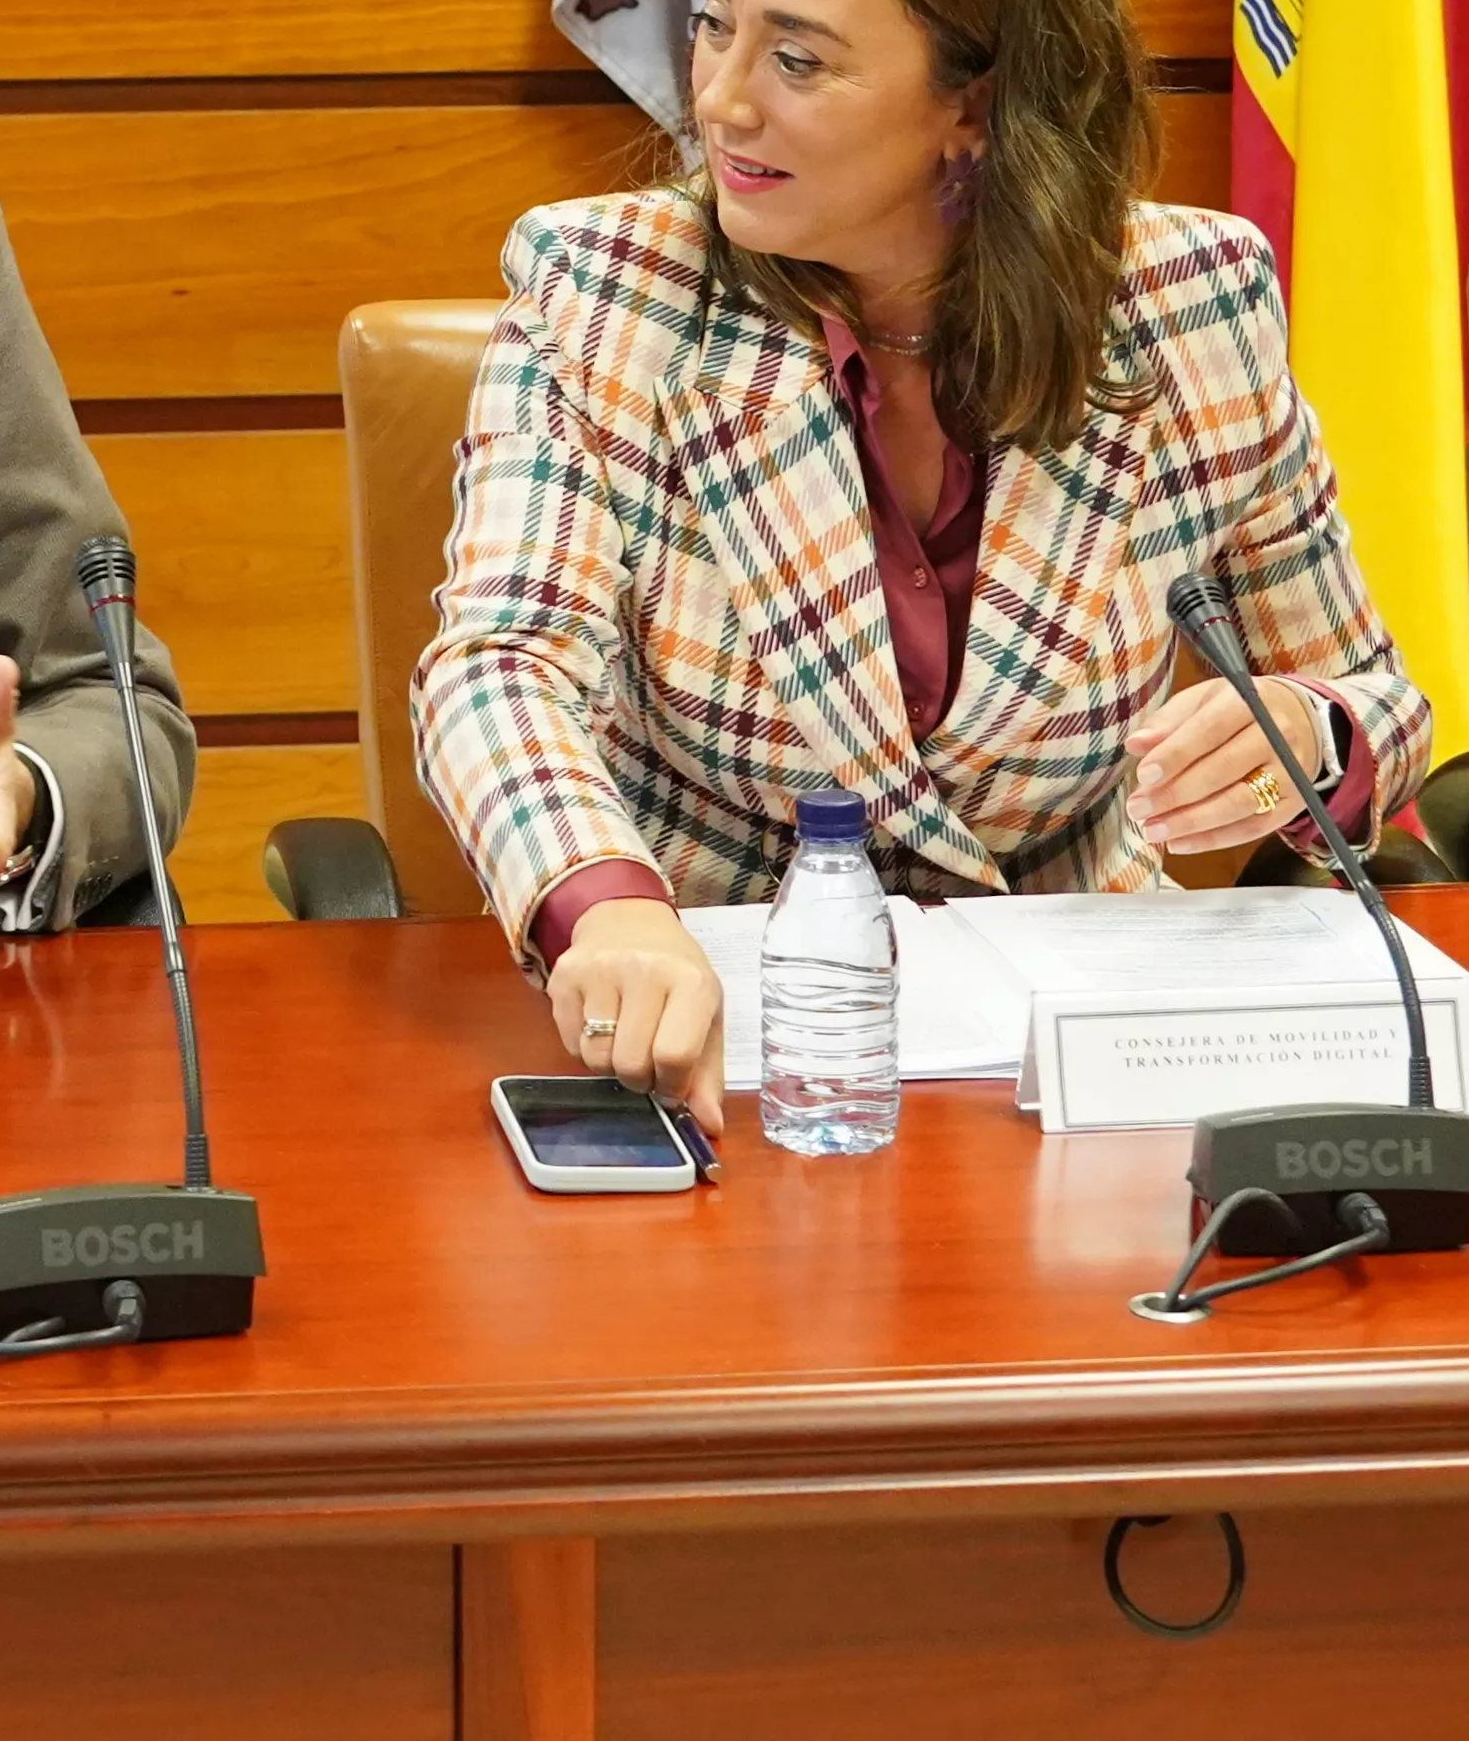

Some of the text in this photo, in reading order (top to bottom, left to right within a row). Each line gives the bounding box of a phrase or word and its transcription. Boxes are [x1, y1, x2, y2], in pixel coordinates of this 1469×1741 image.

[1114, 1028, 1401, 1050] CONSEJERA DE MOVILIDAD Y
[1123, 1046, 1393, 1069] TRANSFORMACIÓN DIGITAL
[1275, 1138, 1433, 1179] BOSCH
[41, 1220, 204, 1268] BOSCH
